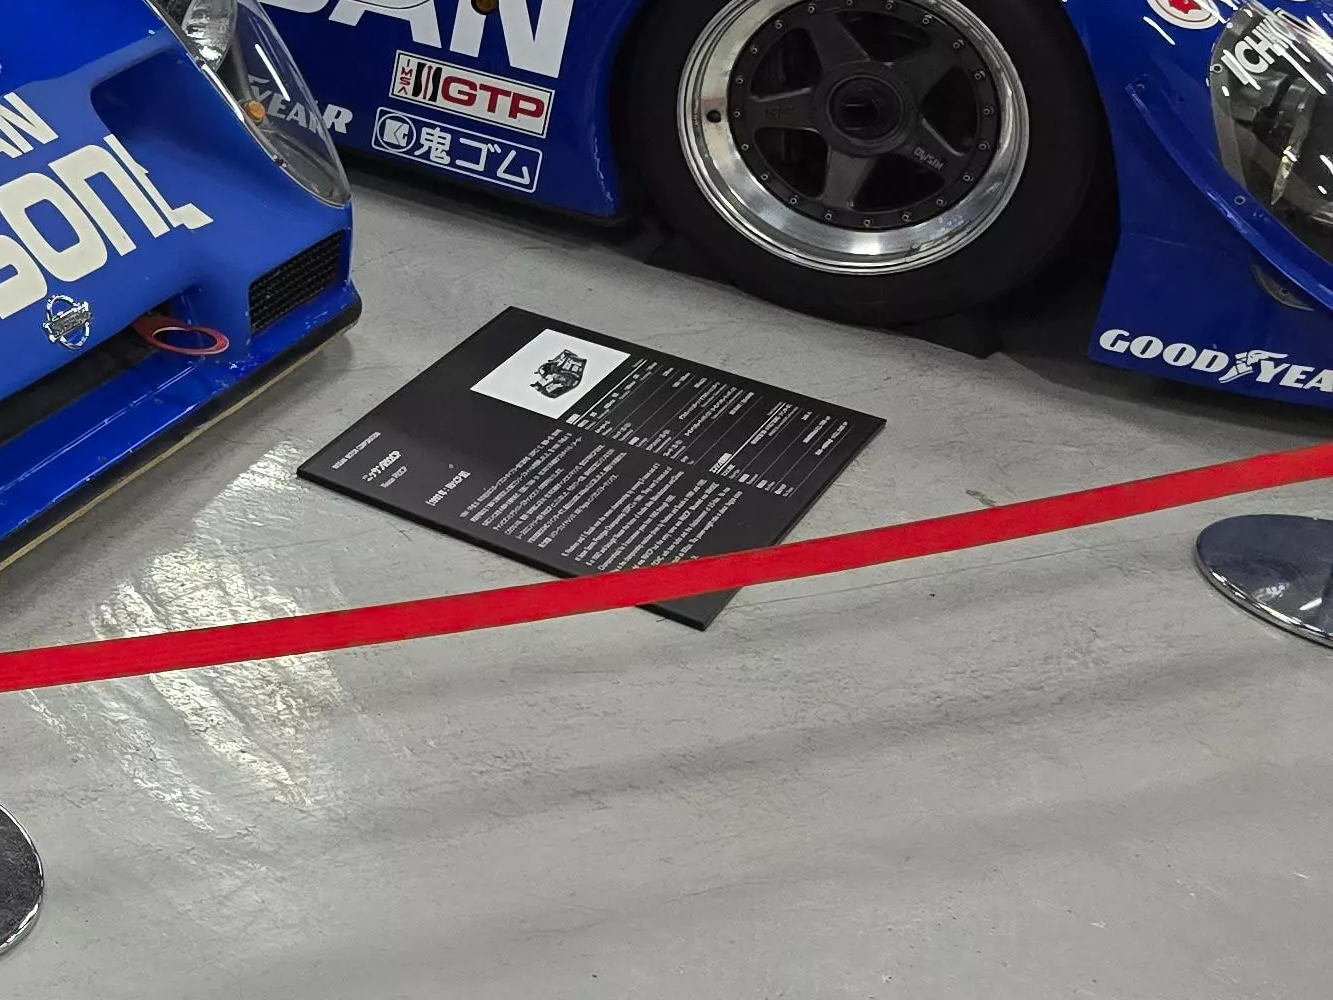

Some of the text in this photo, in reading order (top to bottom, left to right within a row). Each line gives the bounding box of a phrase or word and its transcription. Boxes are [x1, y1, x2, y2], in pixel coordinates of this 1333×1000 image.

[440, 76, 546, 120] GTP
[414, 126, 531, 187] 鬼ゴム
[1099, 328, 1333, 392] GOODYEA
